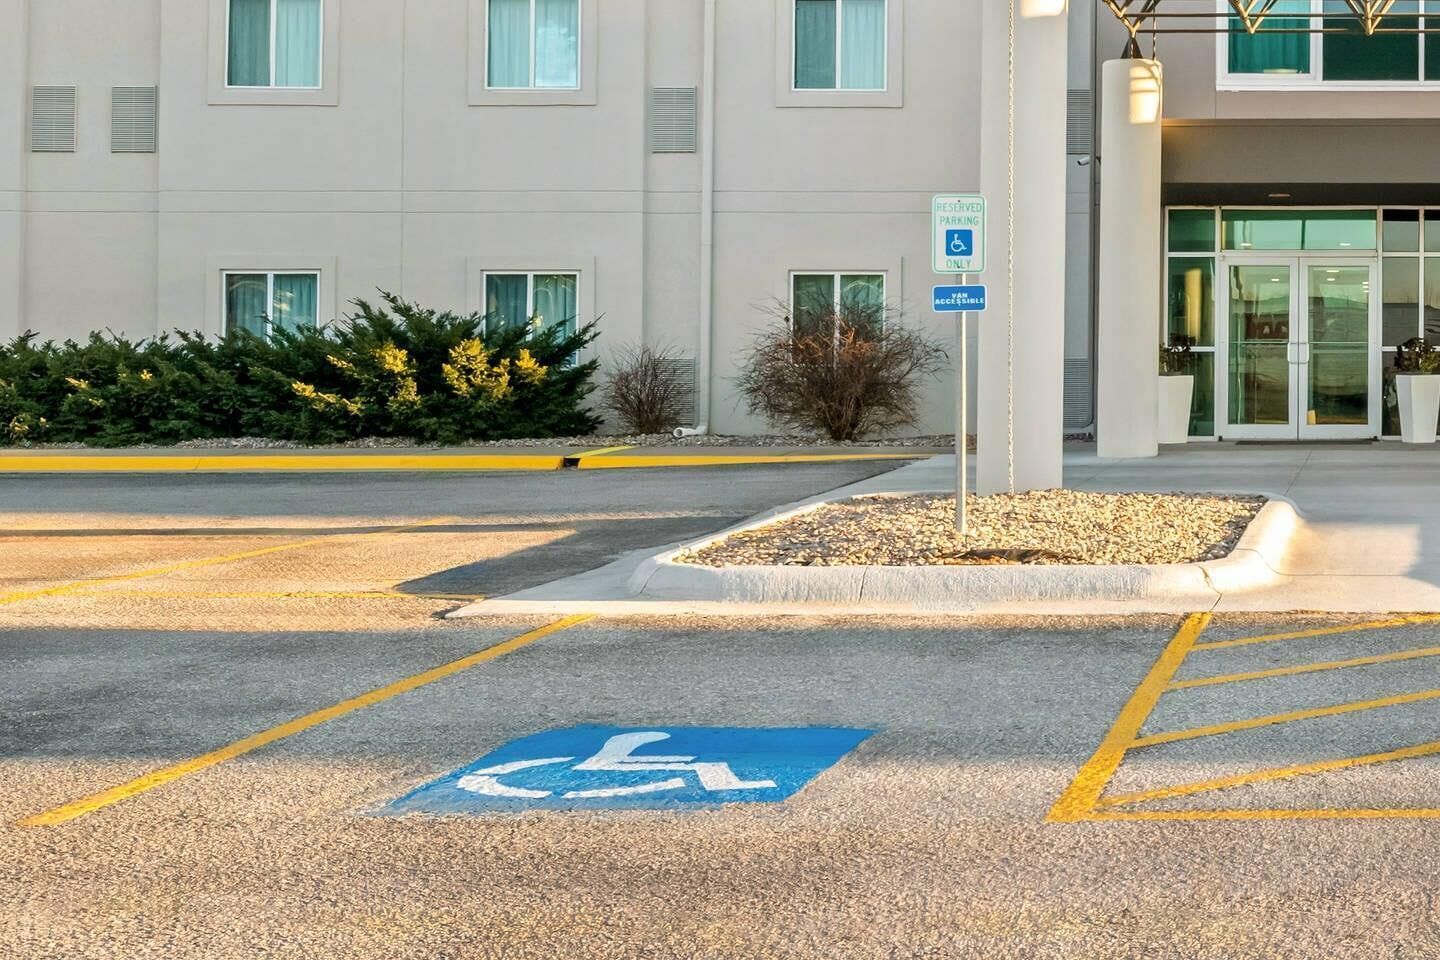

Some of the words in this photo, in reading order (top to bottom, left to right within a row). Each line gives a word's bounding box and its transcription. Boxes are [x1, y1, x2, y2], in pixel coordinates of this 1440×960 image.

[936, 202, 982, 213] RESERVED
[940, 215, 979, 226] PARKING
[946, 259, 971, 269] ONLY
[934, 297, 985, 305] ACCESSIBLE
